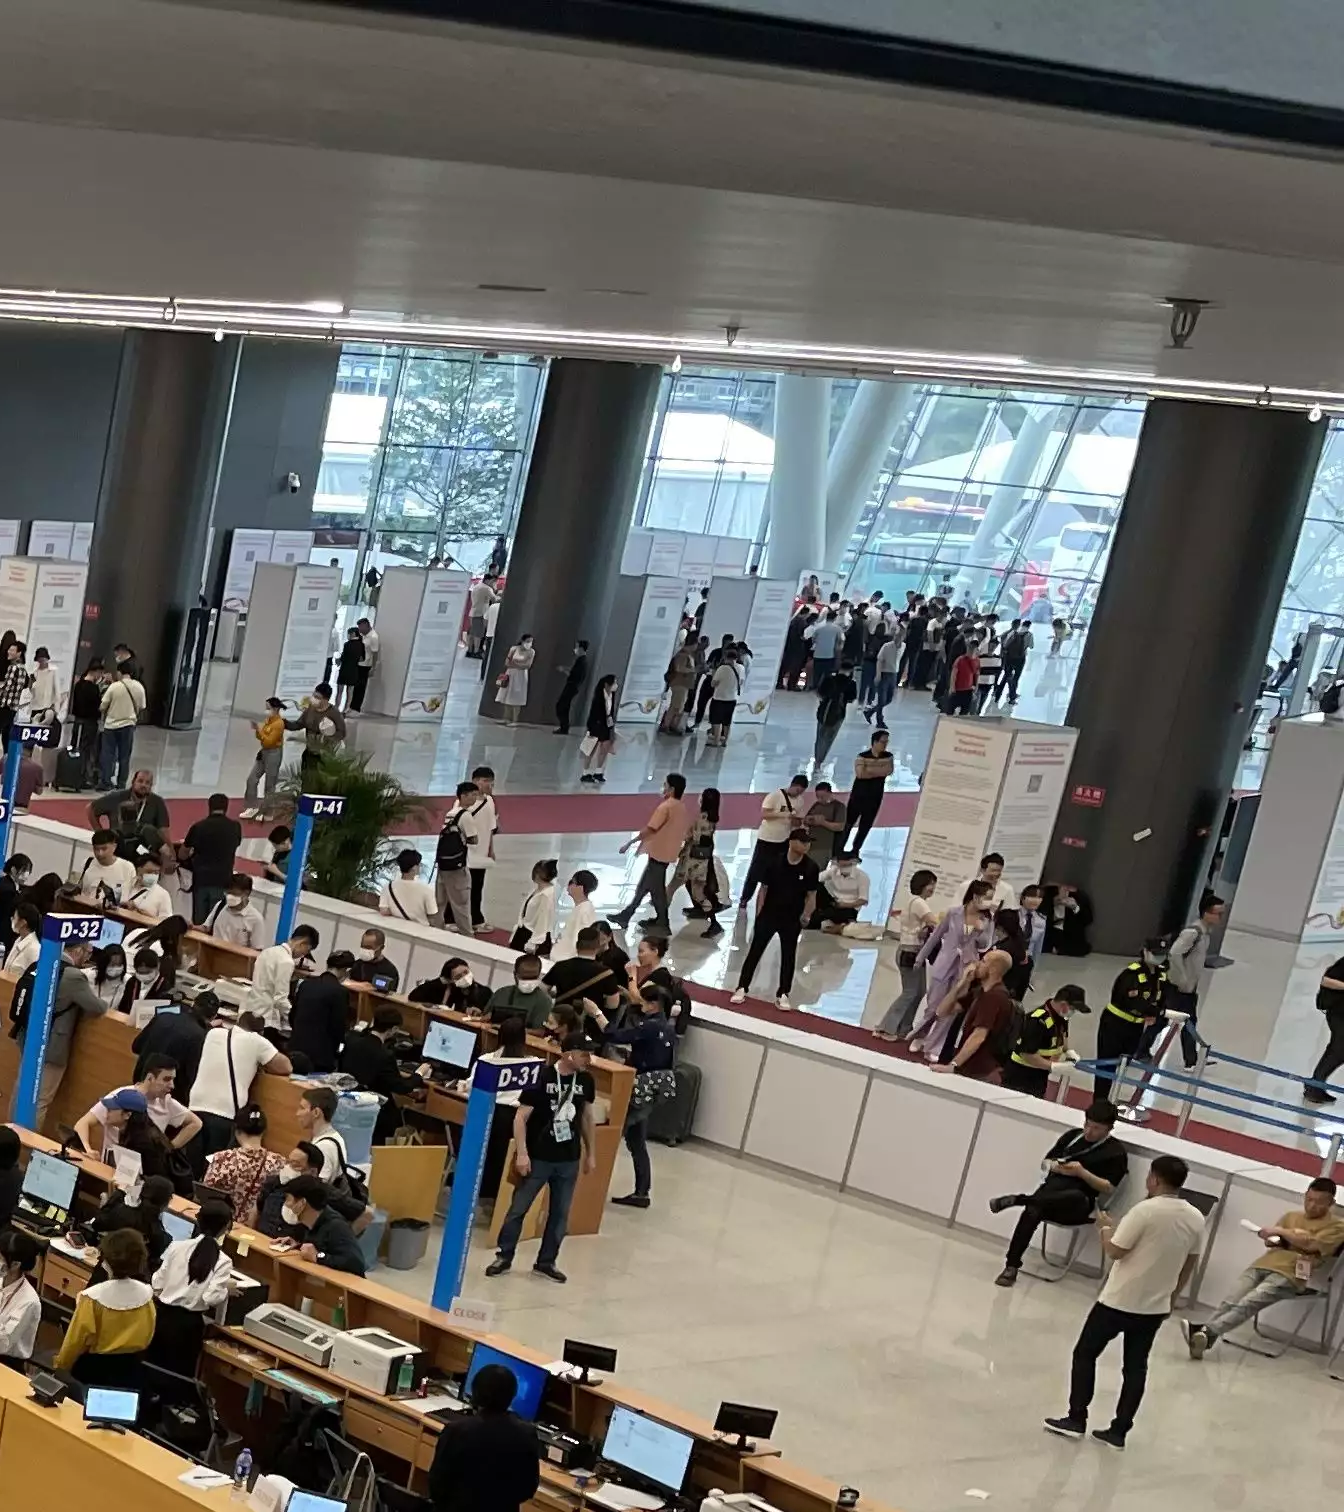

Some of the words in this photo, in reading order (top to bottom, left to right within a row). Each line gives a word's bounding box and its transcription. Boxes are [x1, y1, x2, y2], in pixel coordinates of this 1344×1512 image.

[22, 728, 49, 740] D-42
[314, 801, 342, 814] D-41
[60, 921, 99, 938] D-32
[498, 1065, 539, 1087] D-31
[453, 1307, 487, 1322] CLOSE
